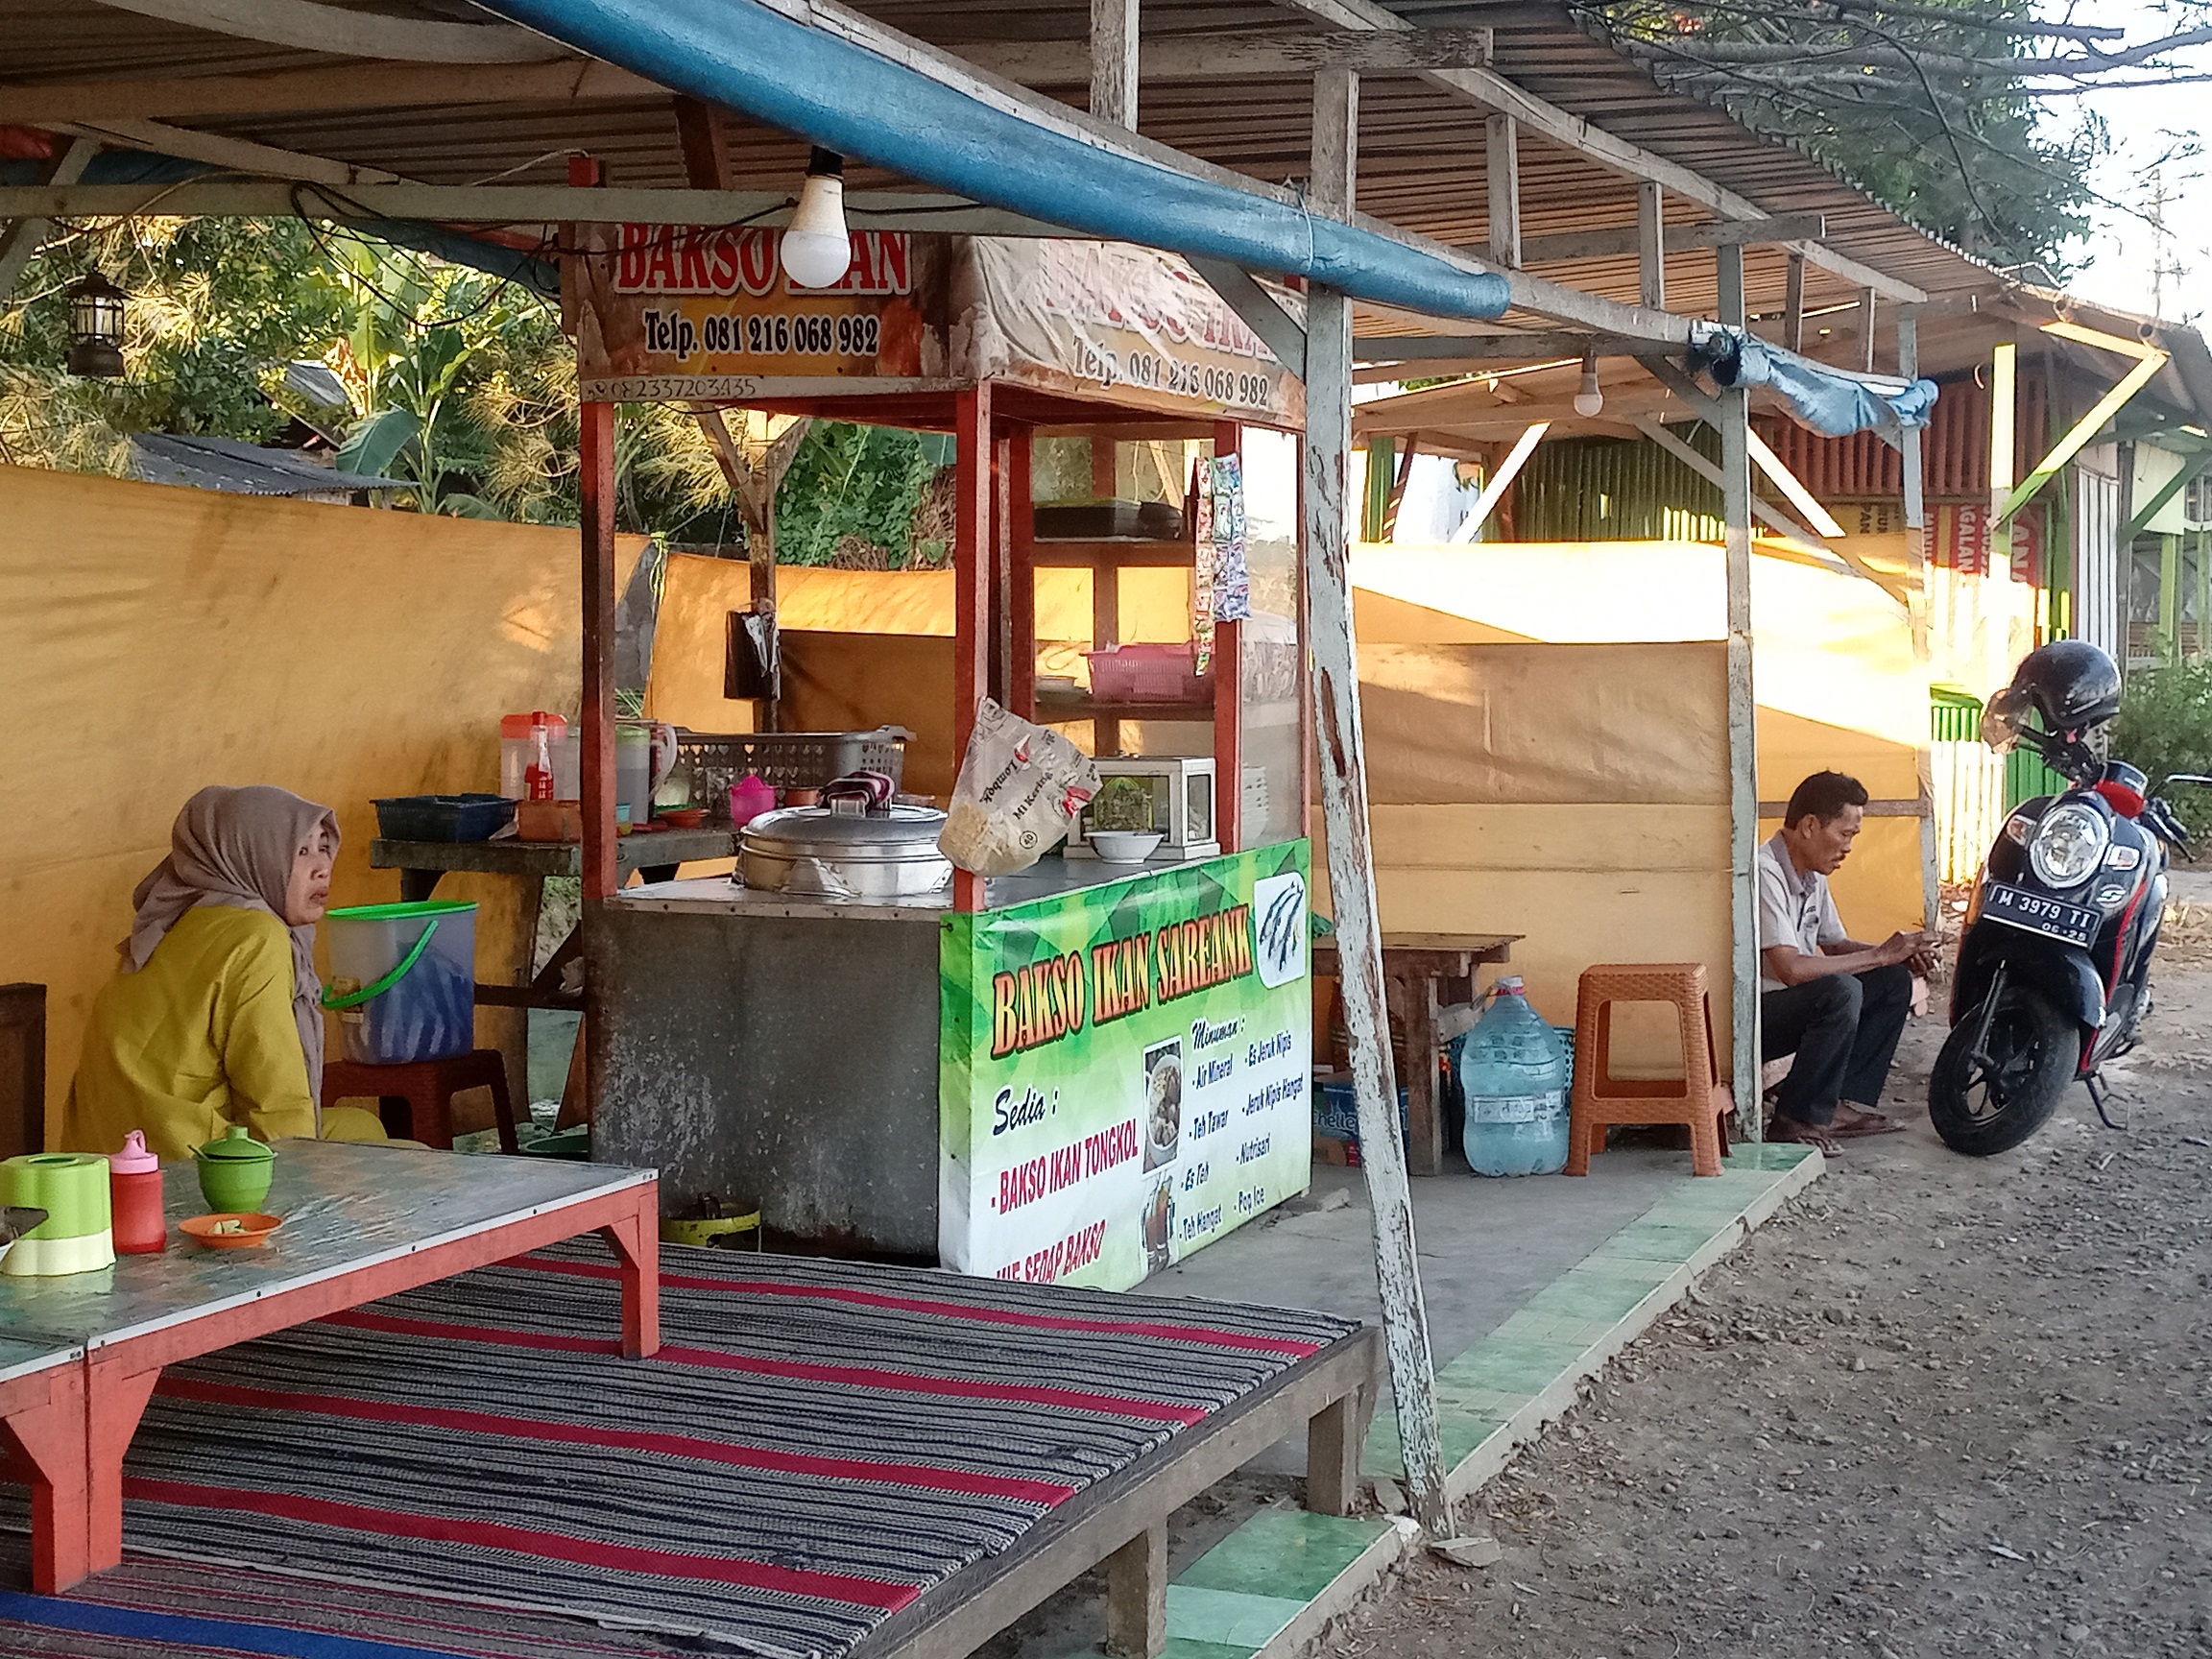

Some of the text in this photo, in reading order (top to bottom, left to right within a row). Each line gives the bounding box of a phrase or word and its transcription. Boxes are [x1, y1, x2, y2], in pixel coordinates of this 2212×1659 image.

[617, 222, 907, 292] BAKSO AN
[645, 309, 878, 361] Telp. 081 216 068 982
[1130, 352, 1161, 384] 081
[1204, 368, 1235, 401] 068
[1238, 374, 1268, 406] 982
[1998, 890, 2091, 927] M 3979 TI
[992, 904, 1253, 1061] BAKSO IKAN SAREANK
[1192, 1020, 1238, 1050] Minuman
[1248, 1030, 1292, 1068] Es Jeruk Nipis
[1196, 1053, 1233, 1090] Air Mineral
[993, 1087, 1046, 1137] Sedia
[1245, 1072, 1304, 1116] Jeruk Nipis Hangat
[1193, 1109, 1229, 1141] Teh Tawar
[999, 1118, 1139, 1215] BAKSO IKAN TONGKOL
[1239, 1133, 1271, 1165] Nutrisari
[1185, 1161, 1210, 1191] Es Teh
[1238, 1186, 1265, 1214] Pop Ice
[1183, 1204, 1222, 1241] Teh Hangat
[1063, 1219, 1106, 1277] BAKSO
